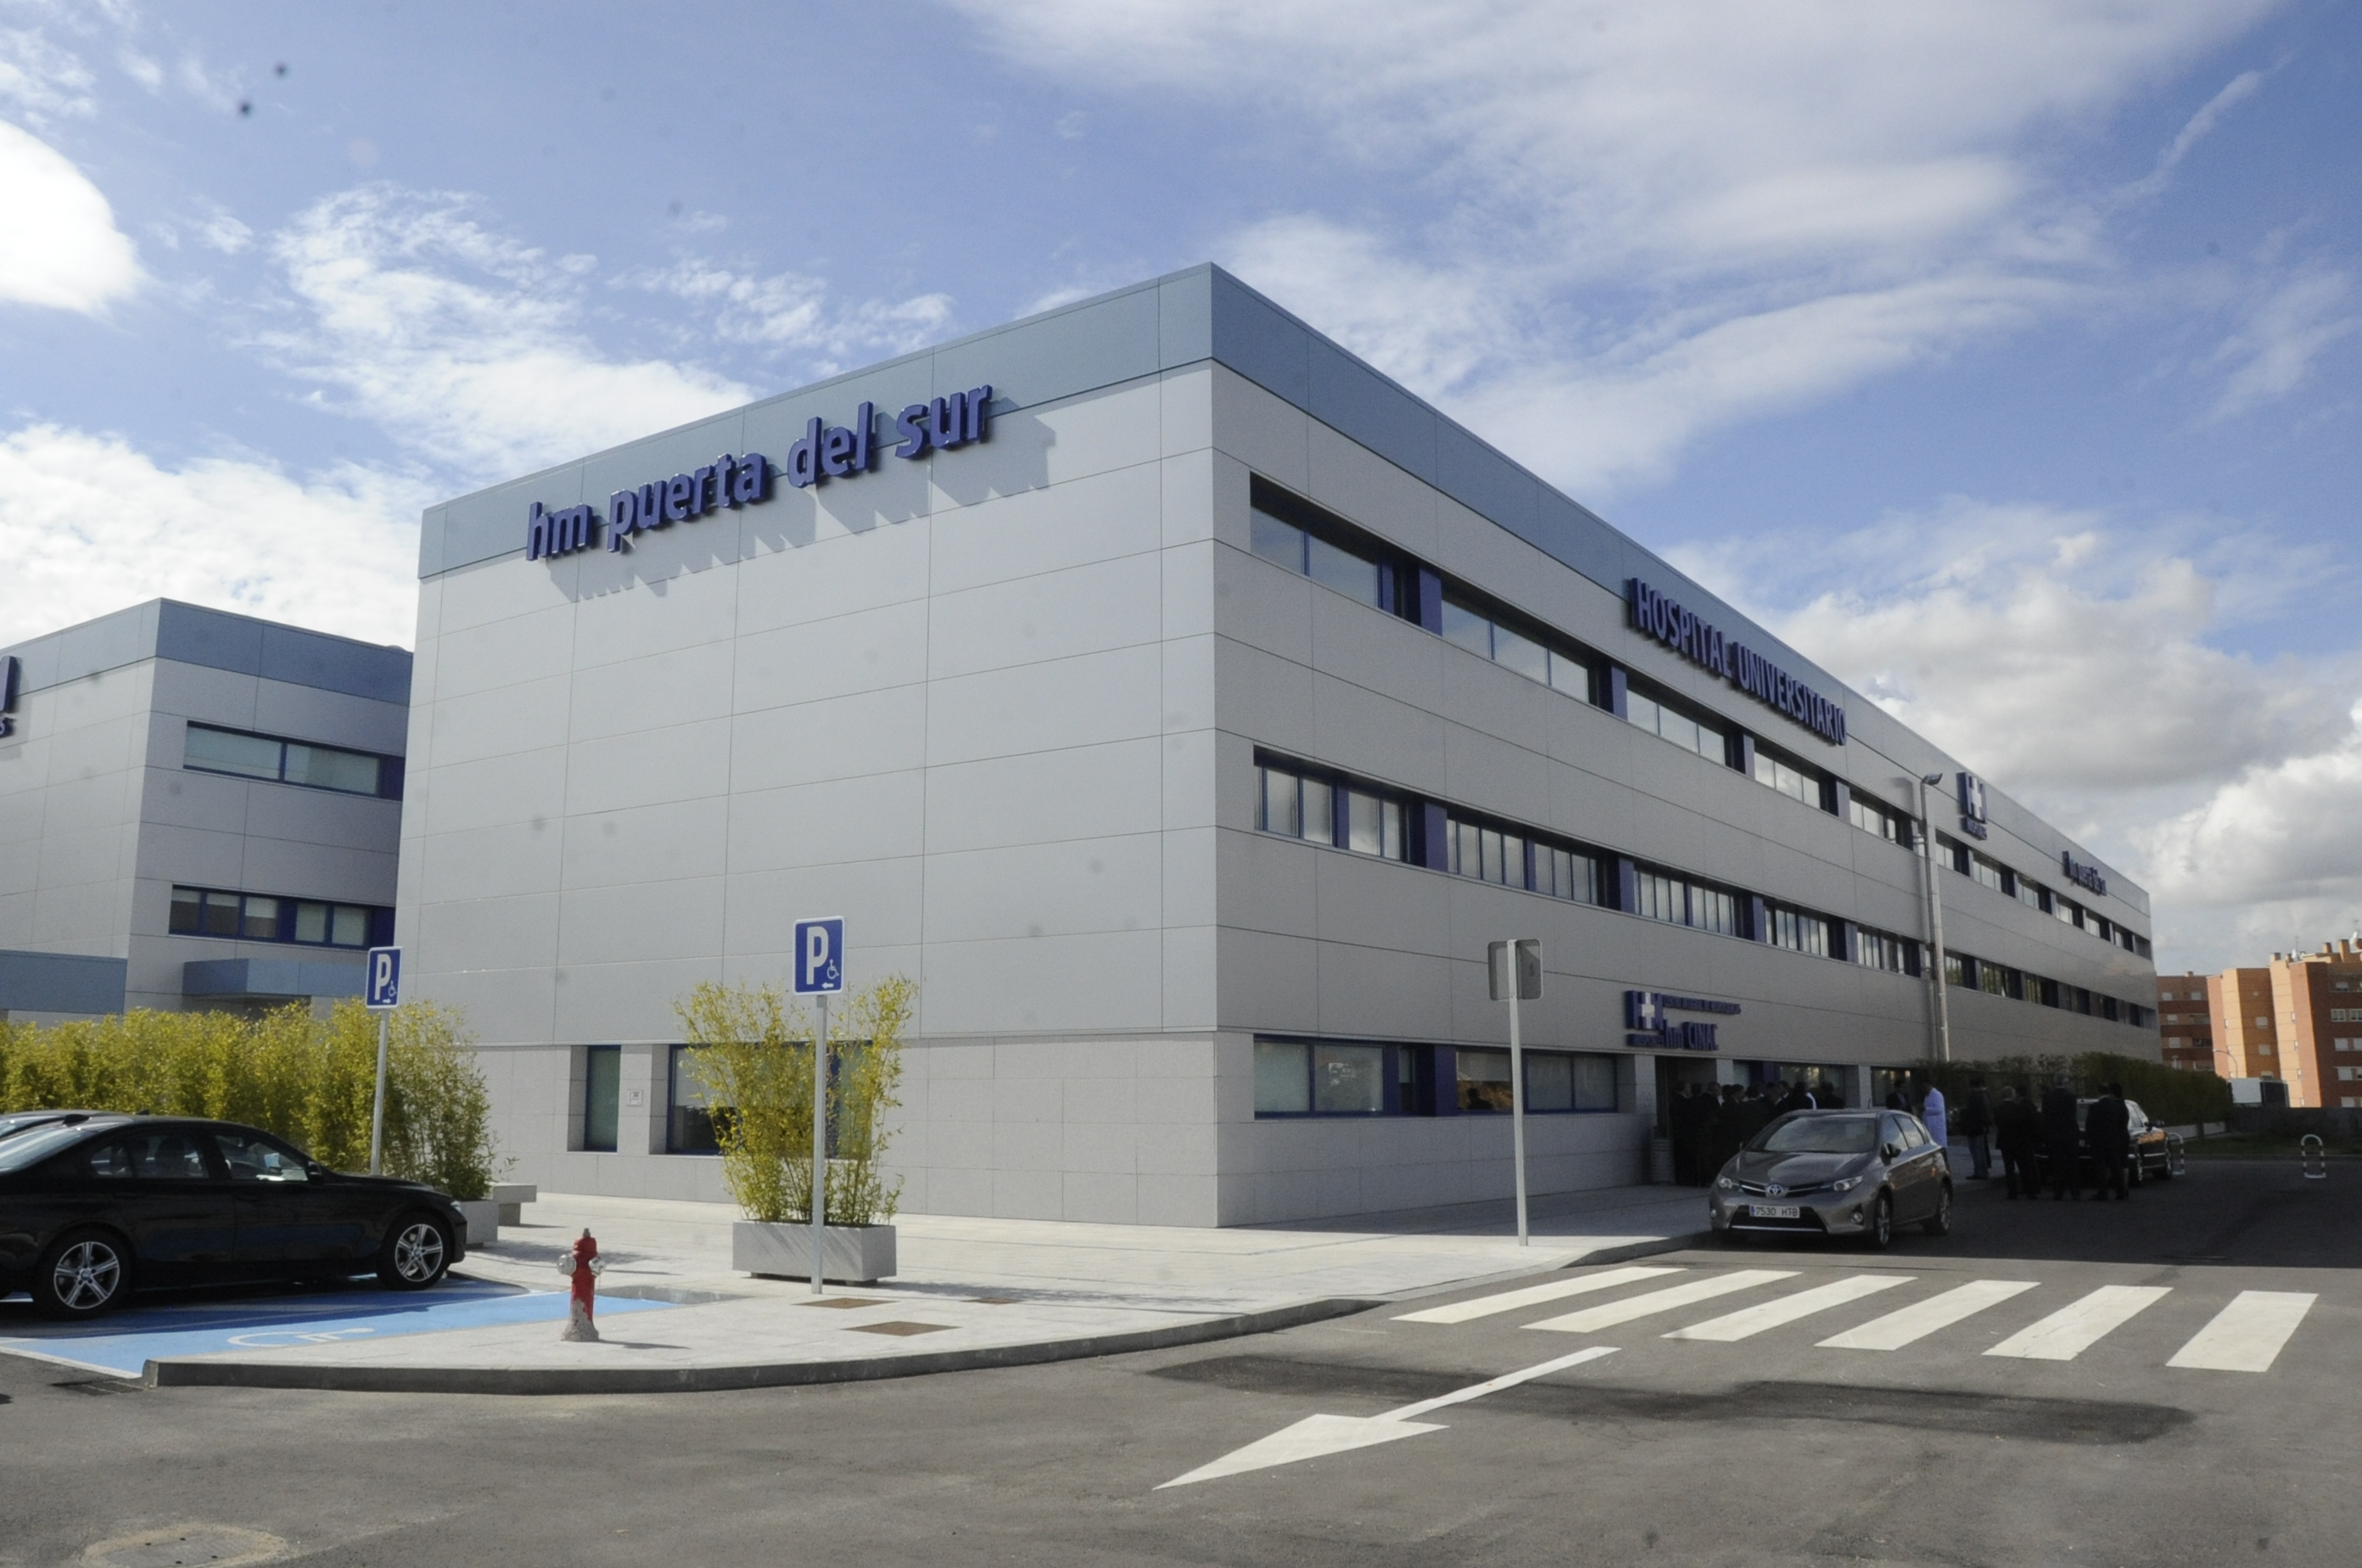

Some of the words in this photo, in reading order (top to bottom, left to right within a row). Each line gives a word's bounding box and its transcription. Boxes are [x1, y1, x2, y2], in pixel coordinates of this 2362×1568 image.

[527, 501, 593, 561] hm
[607, 452, 769, 552] puerta
[787, 400, 874, 489] del
[894, 385, 993, 459] sur
[1631, 578, 1732, 679] HOSPITAL
[1732, 641, 1847, 746] UNIVERSITARIO
[374, 953, 391, 1000] P
[806, 926, 829, 985] P
[1755, 1207, 1777, 1217] 7530
